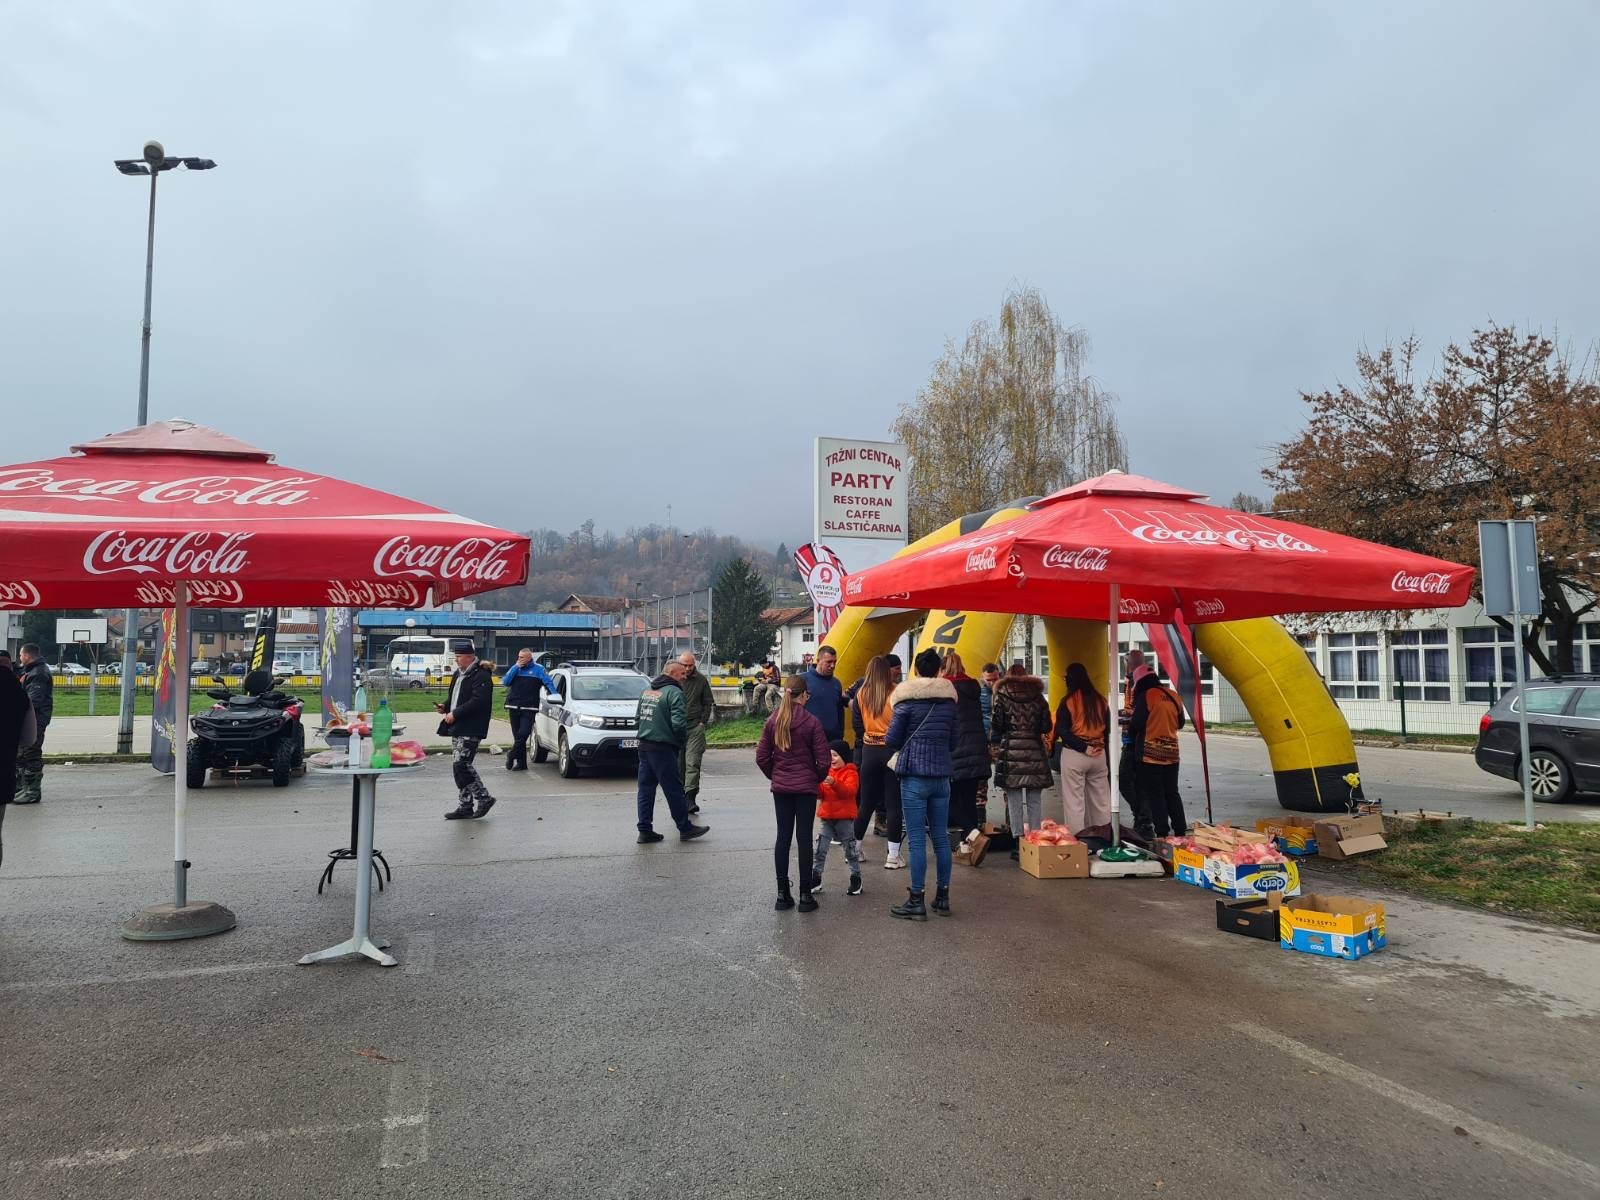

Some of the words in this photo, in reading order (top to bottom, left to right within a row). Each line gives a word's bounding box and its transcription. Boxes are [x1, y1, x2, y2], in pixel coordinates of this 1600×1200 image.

[825, 447, 856, 468] TRŽNI
[859, 448, 901, 472] CENTAR
[831, 472, 895, 490] PARTY
[833, 495, 893, 507] RESTORAN
[846, 509, 881, 520] CAFFE
[824, 520, 902, 533] SLASTIČARNA
[83, 530, 257, 575] Coca-Cola
[373, 535, 518, 580] Coca-Cola
[1042, 544, 1112, 571] Coca-Cola
[1391, 570, 1452, 594] Coca-Cola
[1255, 878, 1284, 891] derby
